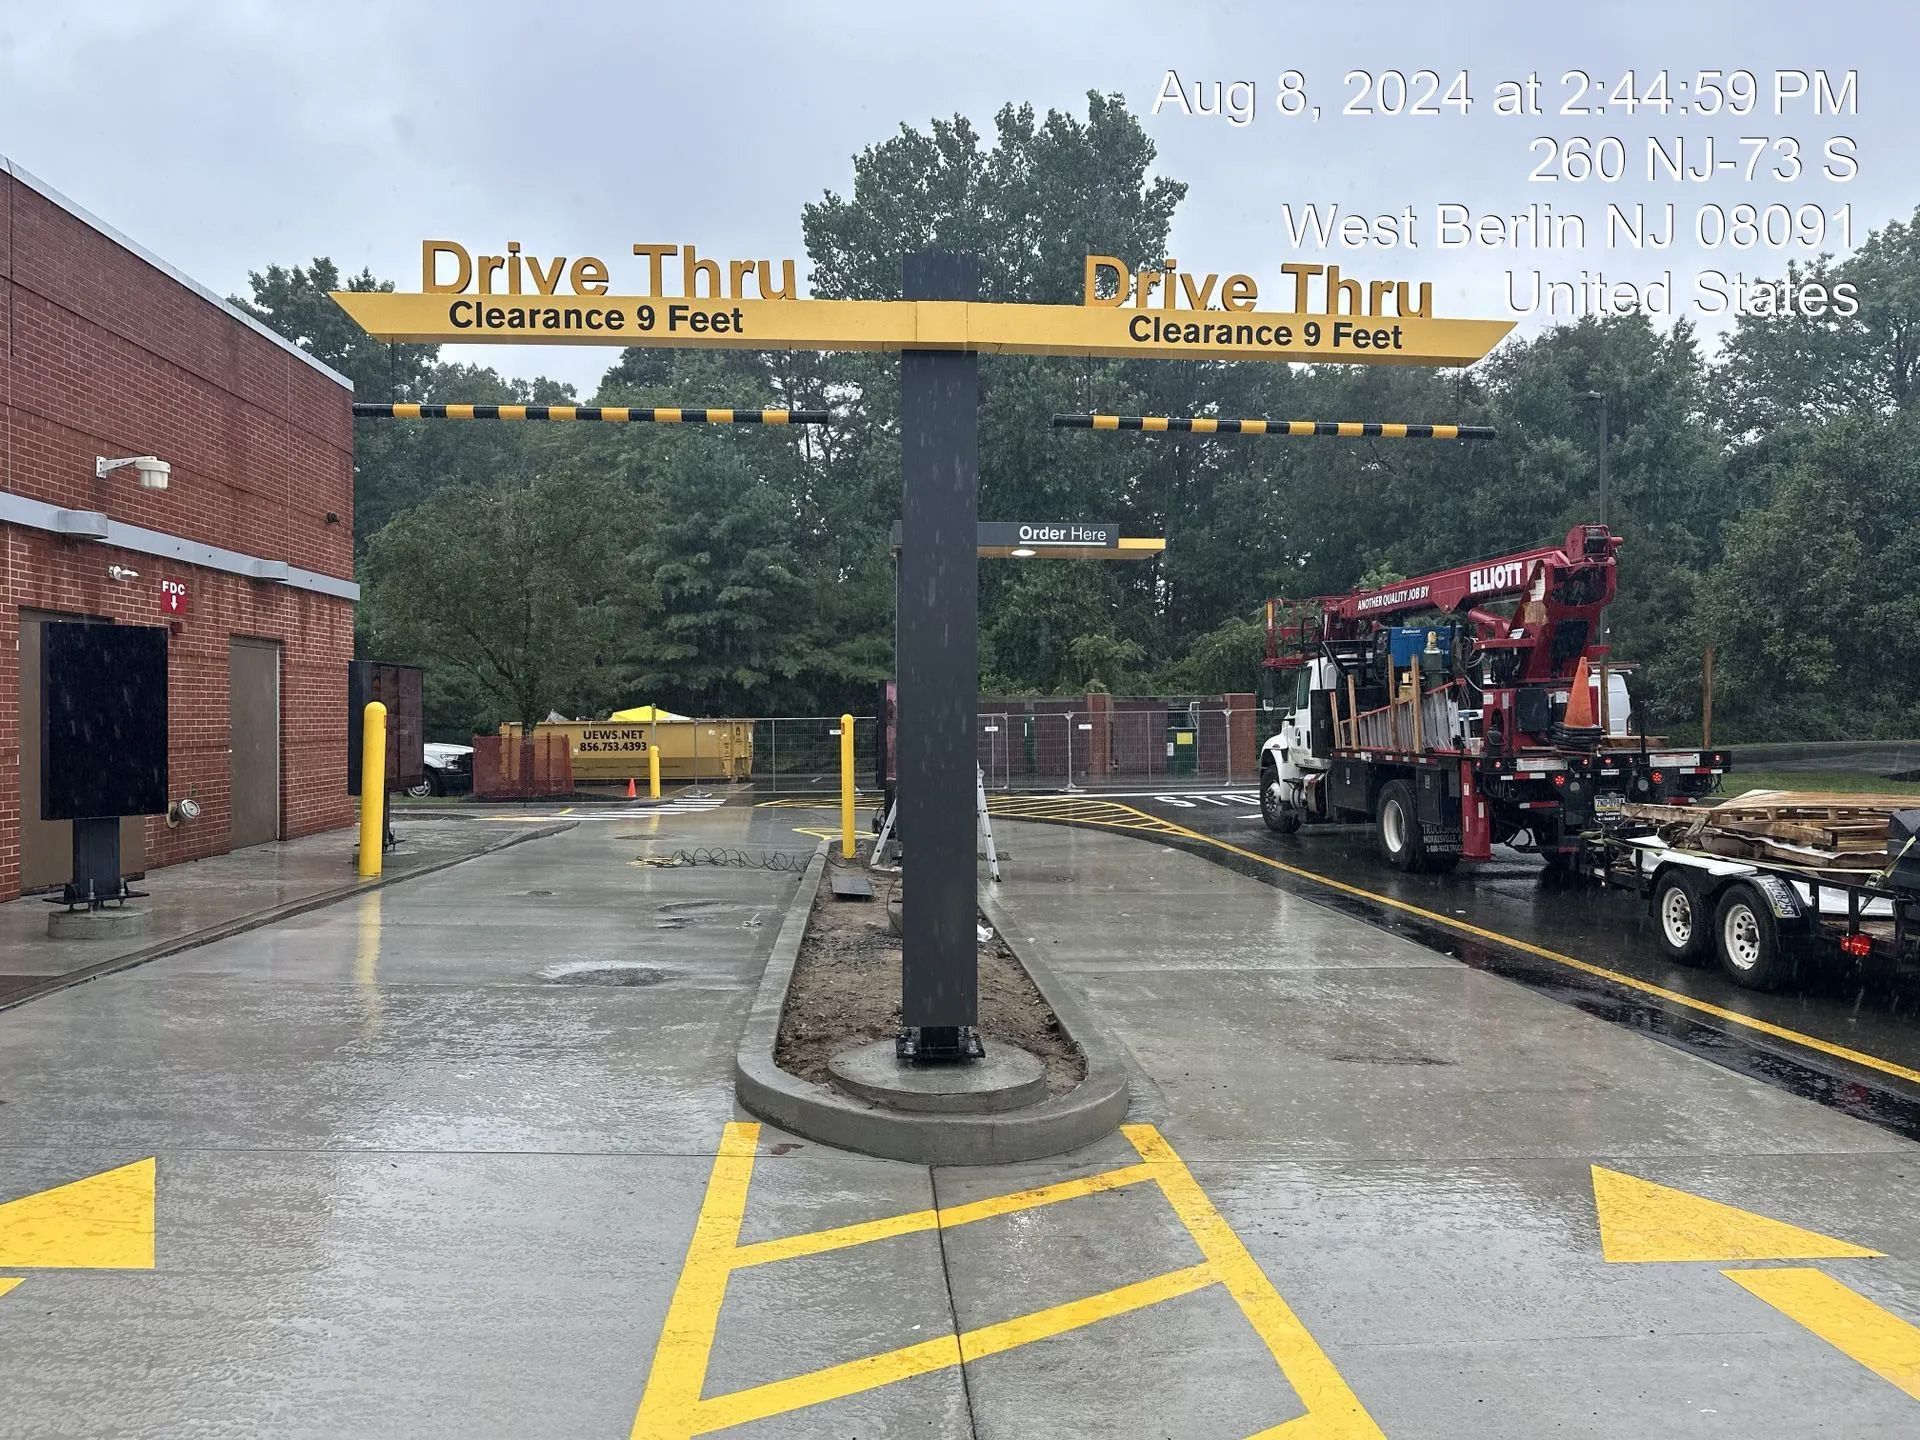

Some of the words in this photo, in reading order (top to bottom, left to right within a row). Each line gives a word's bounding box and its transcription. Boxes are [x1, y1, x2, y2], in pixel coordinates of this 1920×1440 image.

[423, 240, 609, 296] Drive
[633, 243, 798, 300] Thru
[1084, 255, 1258, 313] Drive
[1281, 263, 1432, 318] Thru
[449, 301, 625, 330] Clearance
[637, 305, 655, 331] 9
[669, 305, 743, 333] Feet
[1129, 315, 1292, 345] Clearance
[1304, 321, 1320, 347] 9
[1333, 322, 1403, 349] Feet
[1019, 526, 1066, 540] Order
[1071, 526, 1107, 540] Here
[162, 580, 186, 596] FDC
[1470, 562, 1523, 593] ELLIOTT
[1358, 595, 1383, 611] ANOTHER
[1383, 589, 1408, 607] QUALITY
[1407, 587, 1420, 601] JOB
[1420, 585, 1430, 598] BY
[580, 742, 647, 752] 856.753.4393
[583, 730, 644, 740] UEWS.NET
[1153, 794, 1261, 808] STO
